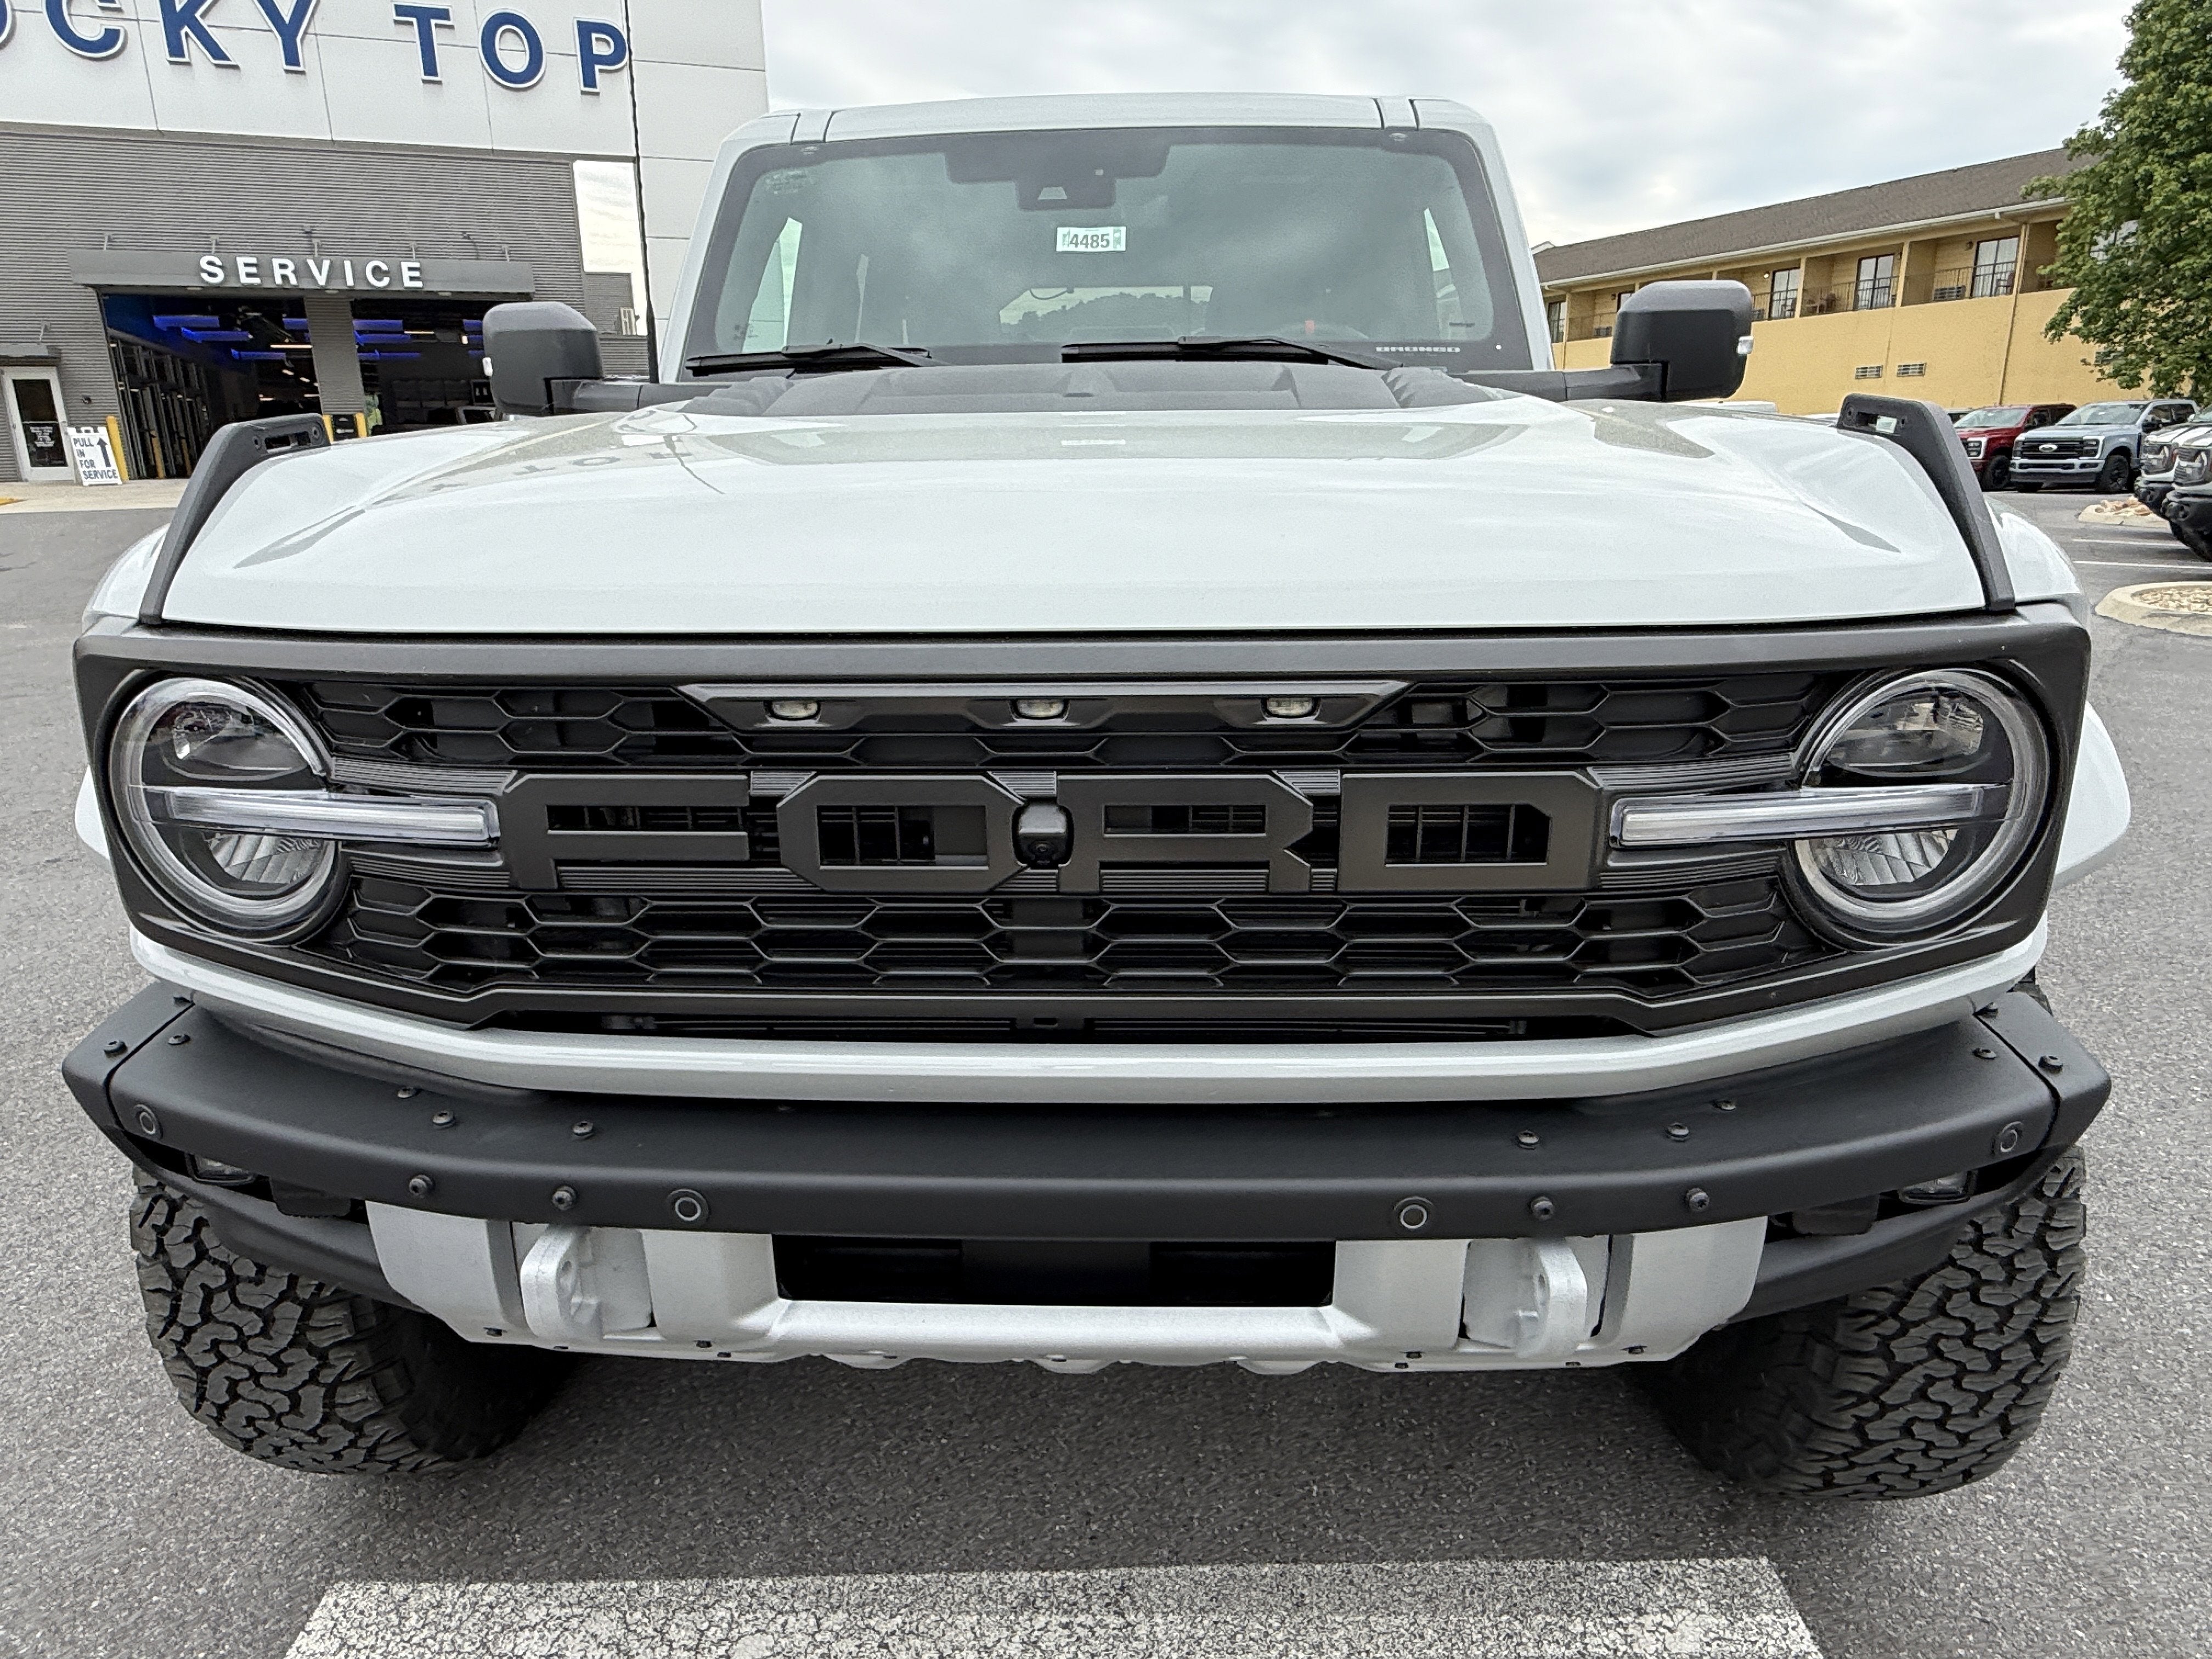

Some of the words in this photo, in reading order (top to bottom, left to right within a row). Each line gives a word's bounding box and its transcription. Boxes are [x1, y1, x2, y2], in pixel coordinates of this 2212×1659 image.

[0, 0, 319, 72] CKY
[393, 2, 628, 93] TOP
[1070, 234, 1110, 249] 4485
[200, 256, 423, 288] SERVICE
[72, 438, 94, 447] PULL
[76, 449, 85, 458] IN
[79, 459, 96, 469] FOR
[82, 469, 118, 480] SERVICE
[502, 774, 1598, 893] FORD
